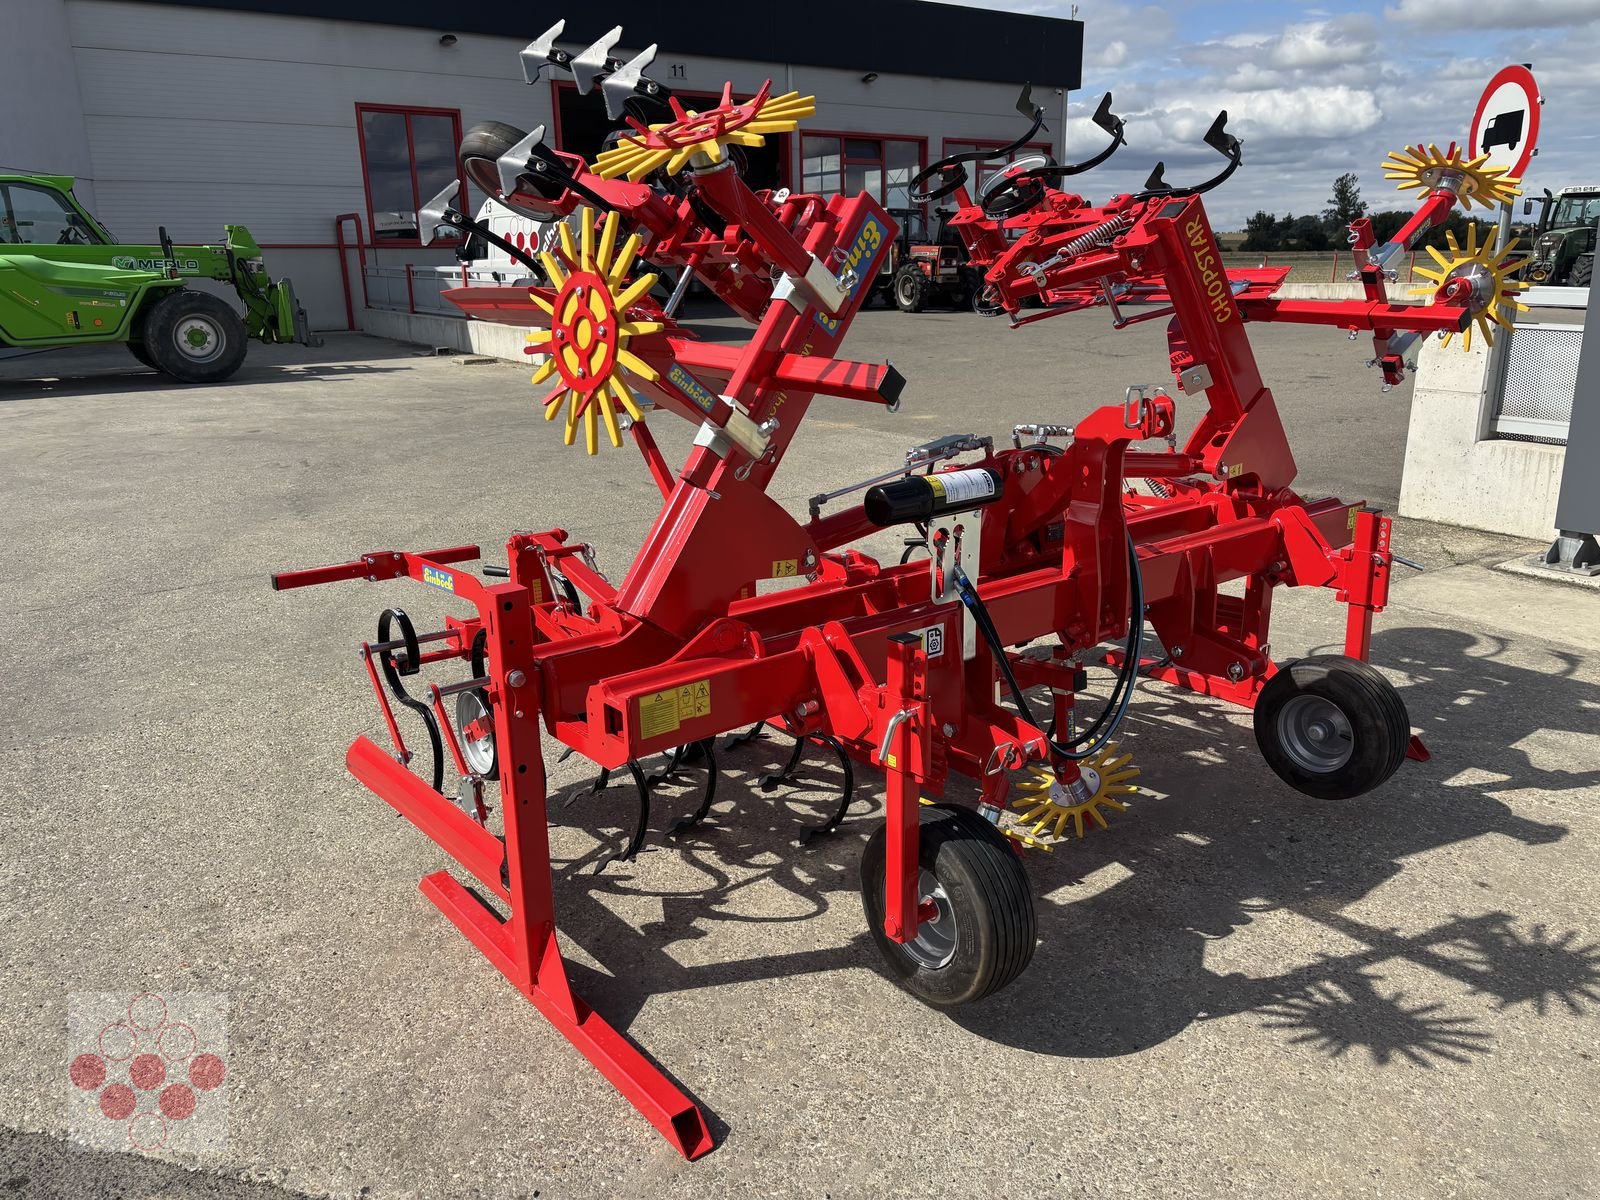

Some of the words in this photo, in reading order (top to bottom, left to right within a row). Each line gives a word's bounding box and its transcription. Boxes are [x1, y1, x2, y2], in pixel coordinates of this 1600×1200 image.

[671, 64, 684, 77] 11
[485, 202, 492, 213] 13
[1186, 214, 1232, 323] CHOPSTAR
[669, 367, 713, 409] Einböck
[424, 567, 454, 591] Einböck
